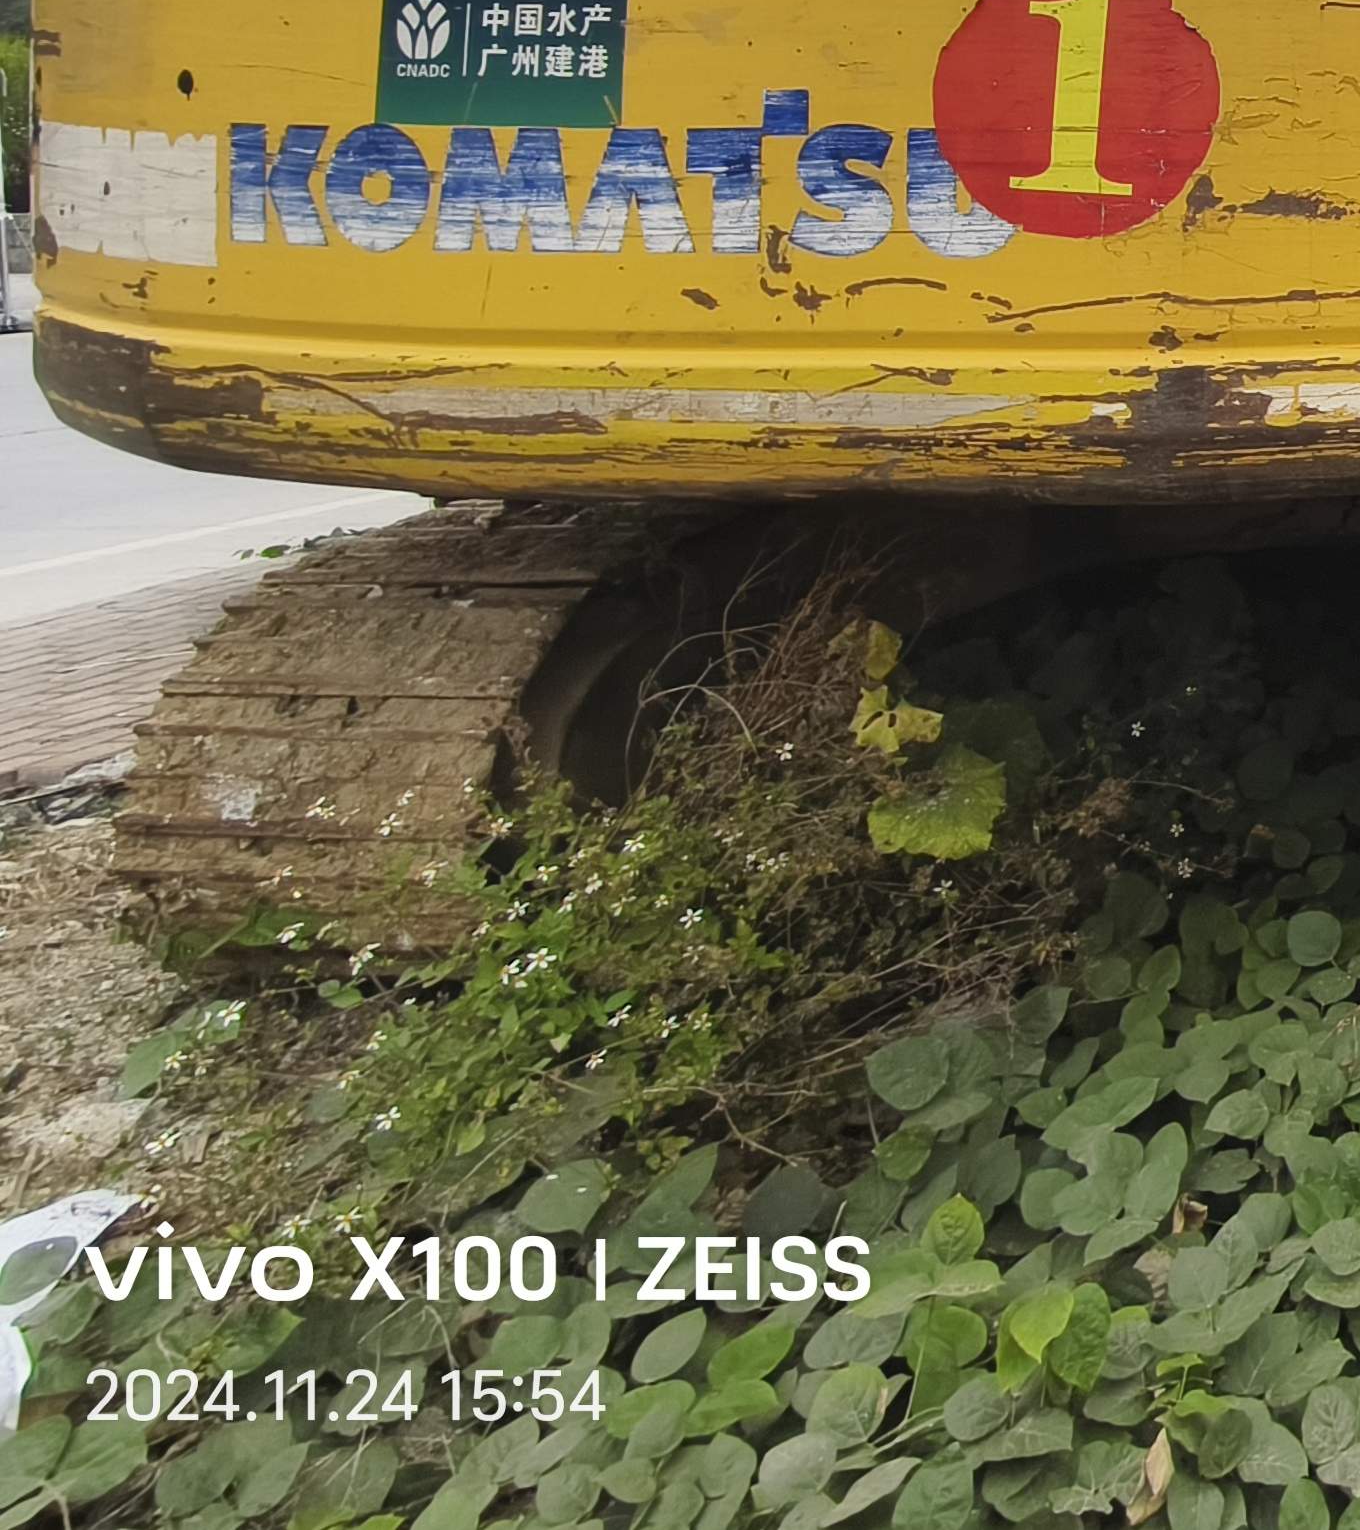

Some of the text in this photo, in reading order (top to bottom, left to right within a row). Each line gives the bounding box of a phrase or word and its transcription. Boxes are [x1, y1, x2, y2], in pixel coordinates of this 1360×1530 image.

[481, 3, 612, 37] 中国水产
[396, 63, 451, 78] CNADC
[477, 44, 609, 79] 广州建港
